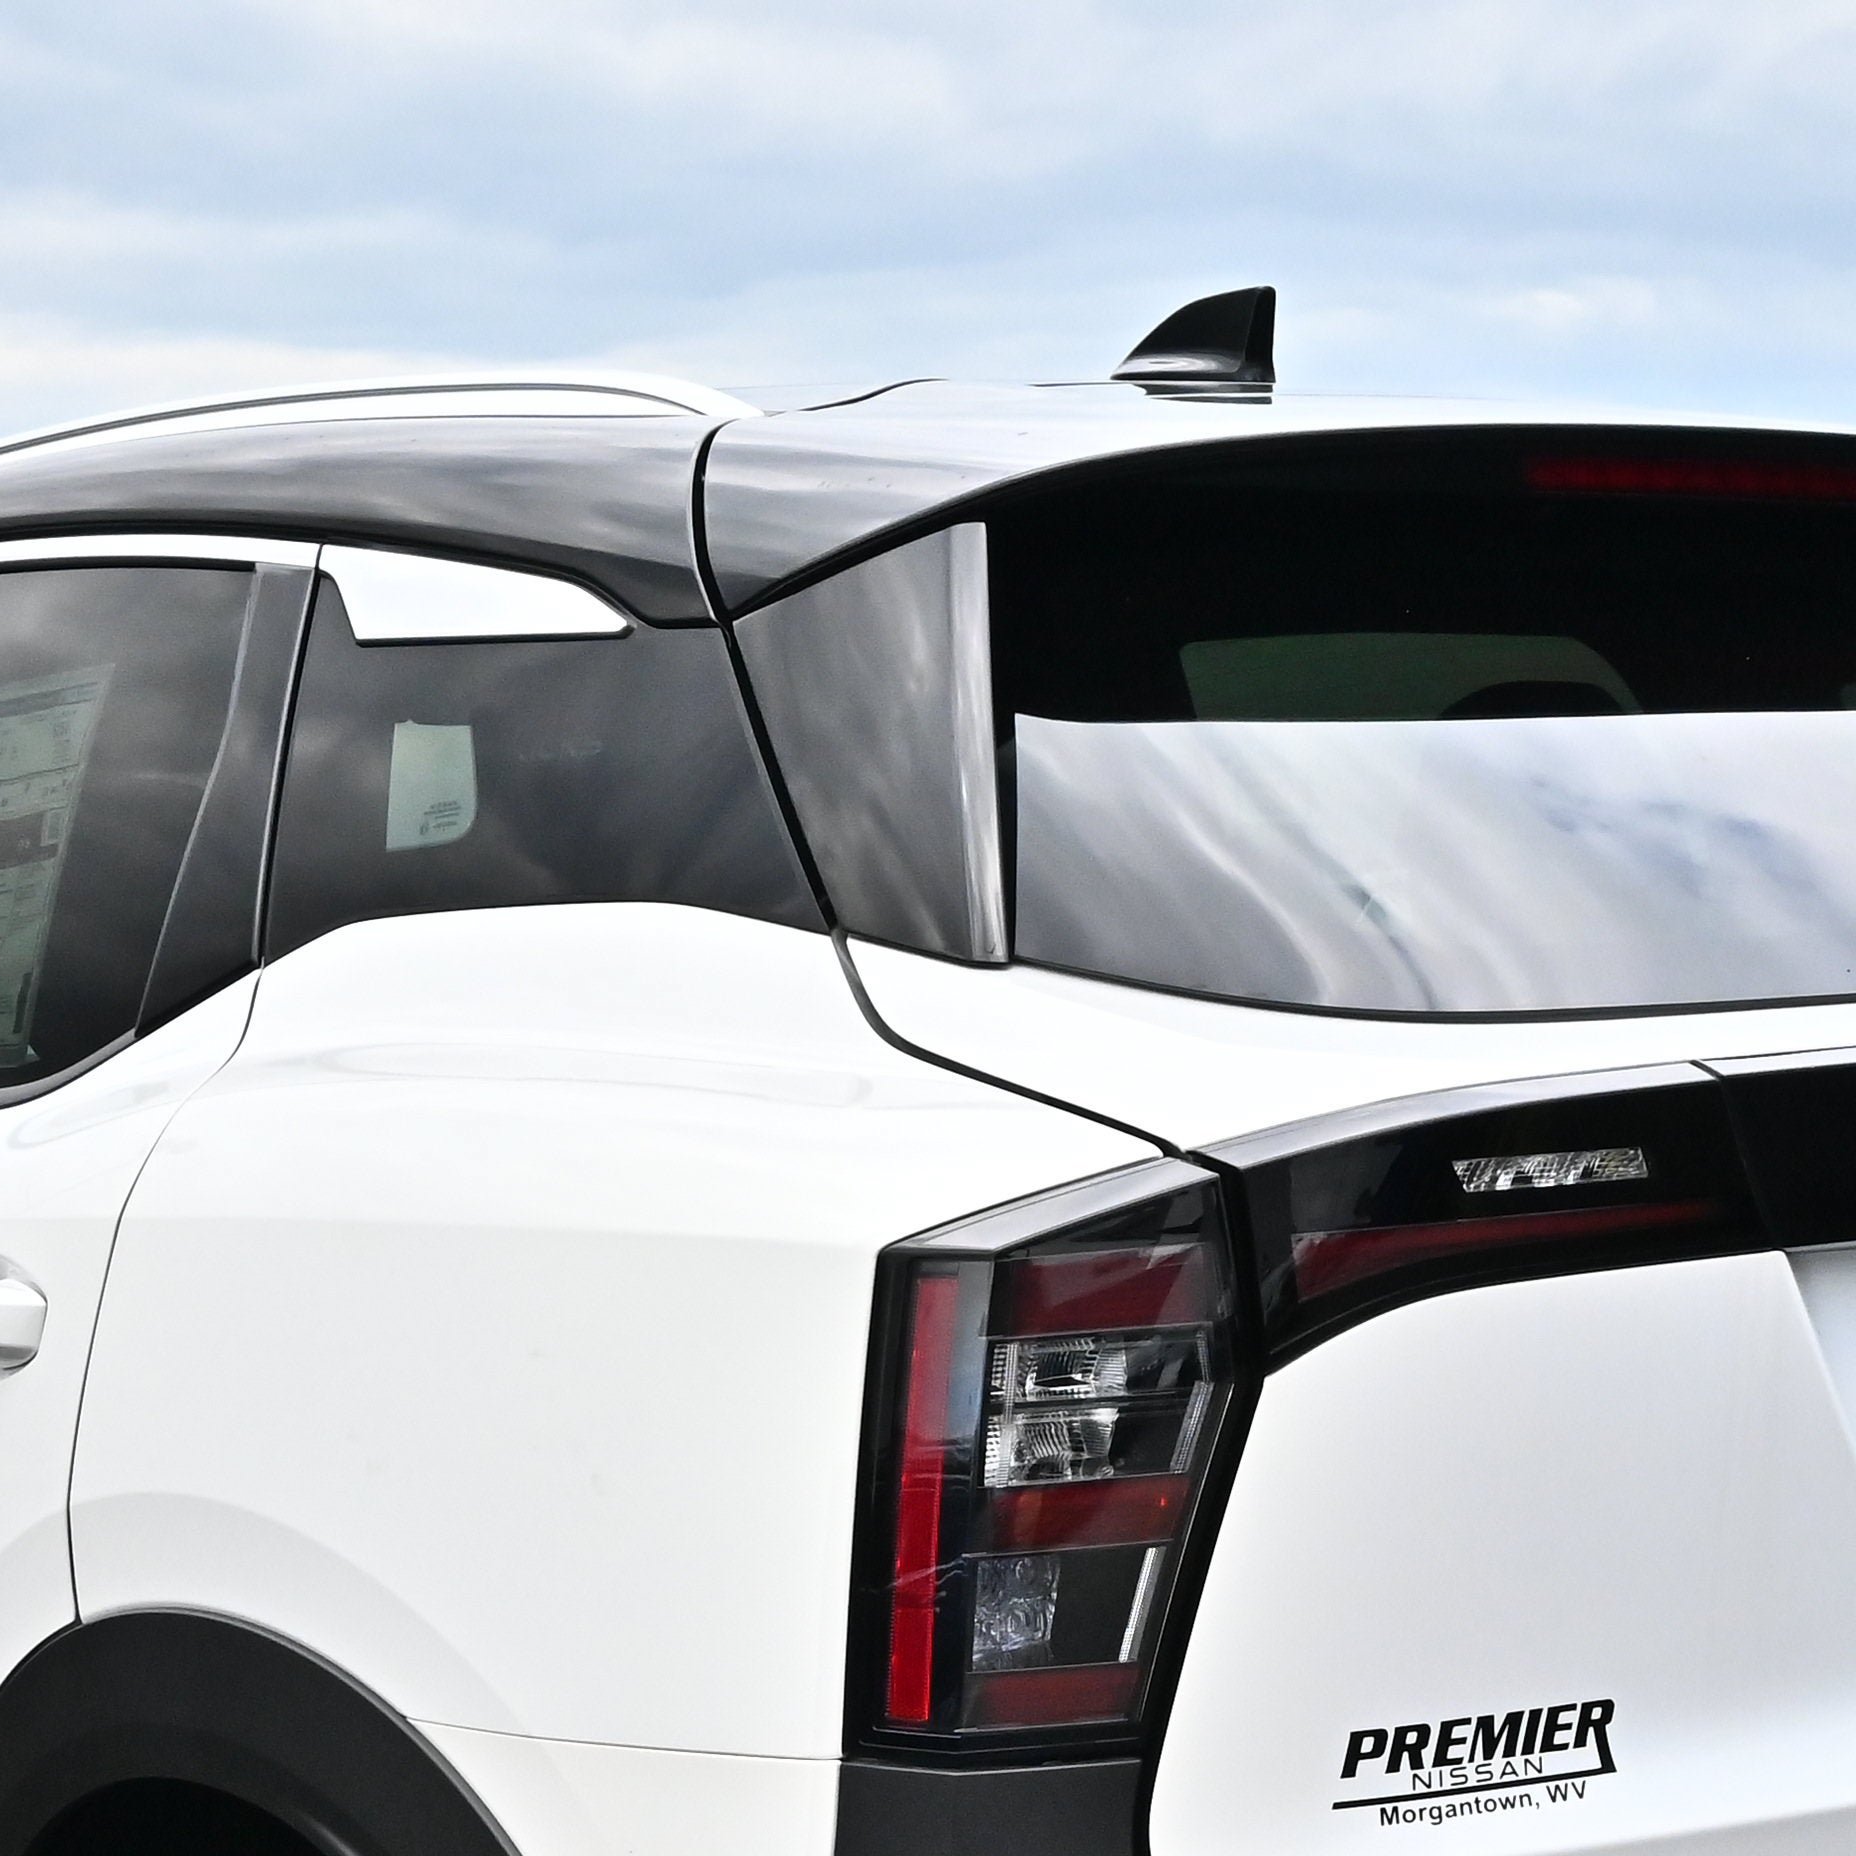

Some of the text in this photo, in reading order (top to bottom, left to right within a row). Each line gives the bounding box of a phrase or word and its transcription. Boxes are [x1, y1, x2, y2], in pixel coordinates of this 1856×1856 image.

[1339, 1698, 1617, 1780] PREMIER
[1411, 1755, 1545, 1792] NISSAN
[1379, 1780, 1587, 1826] Morgantown, WV
